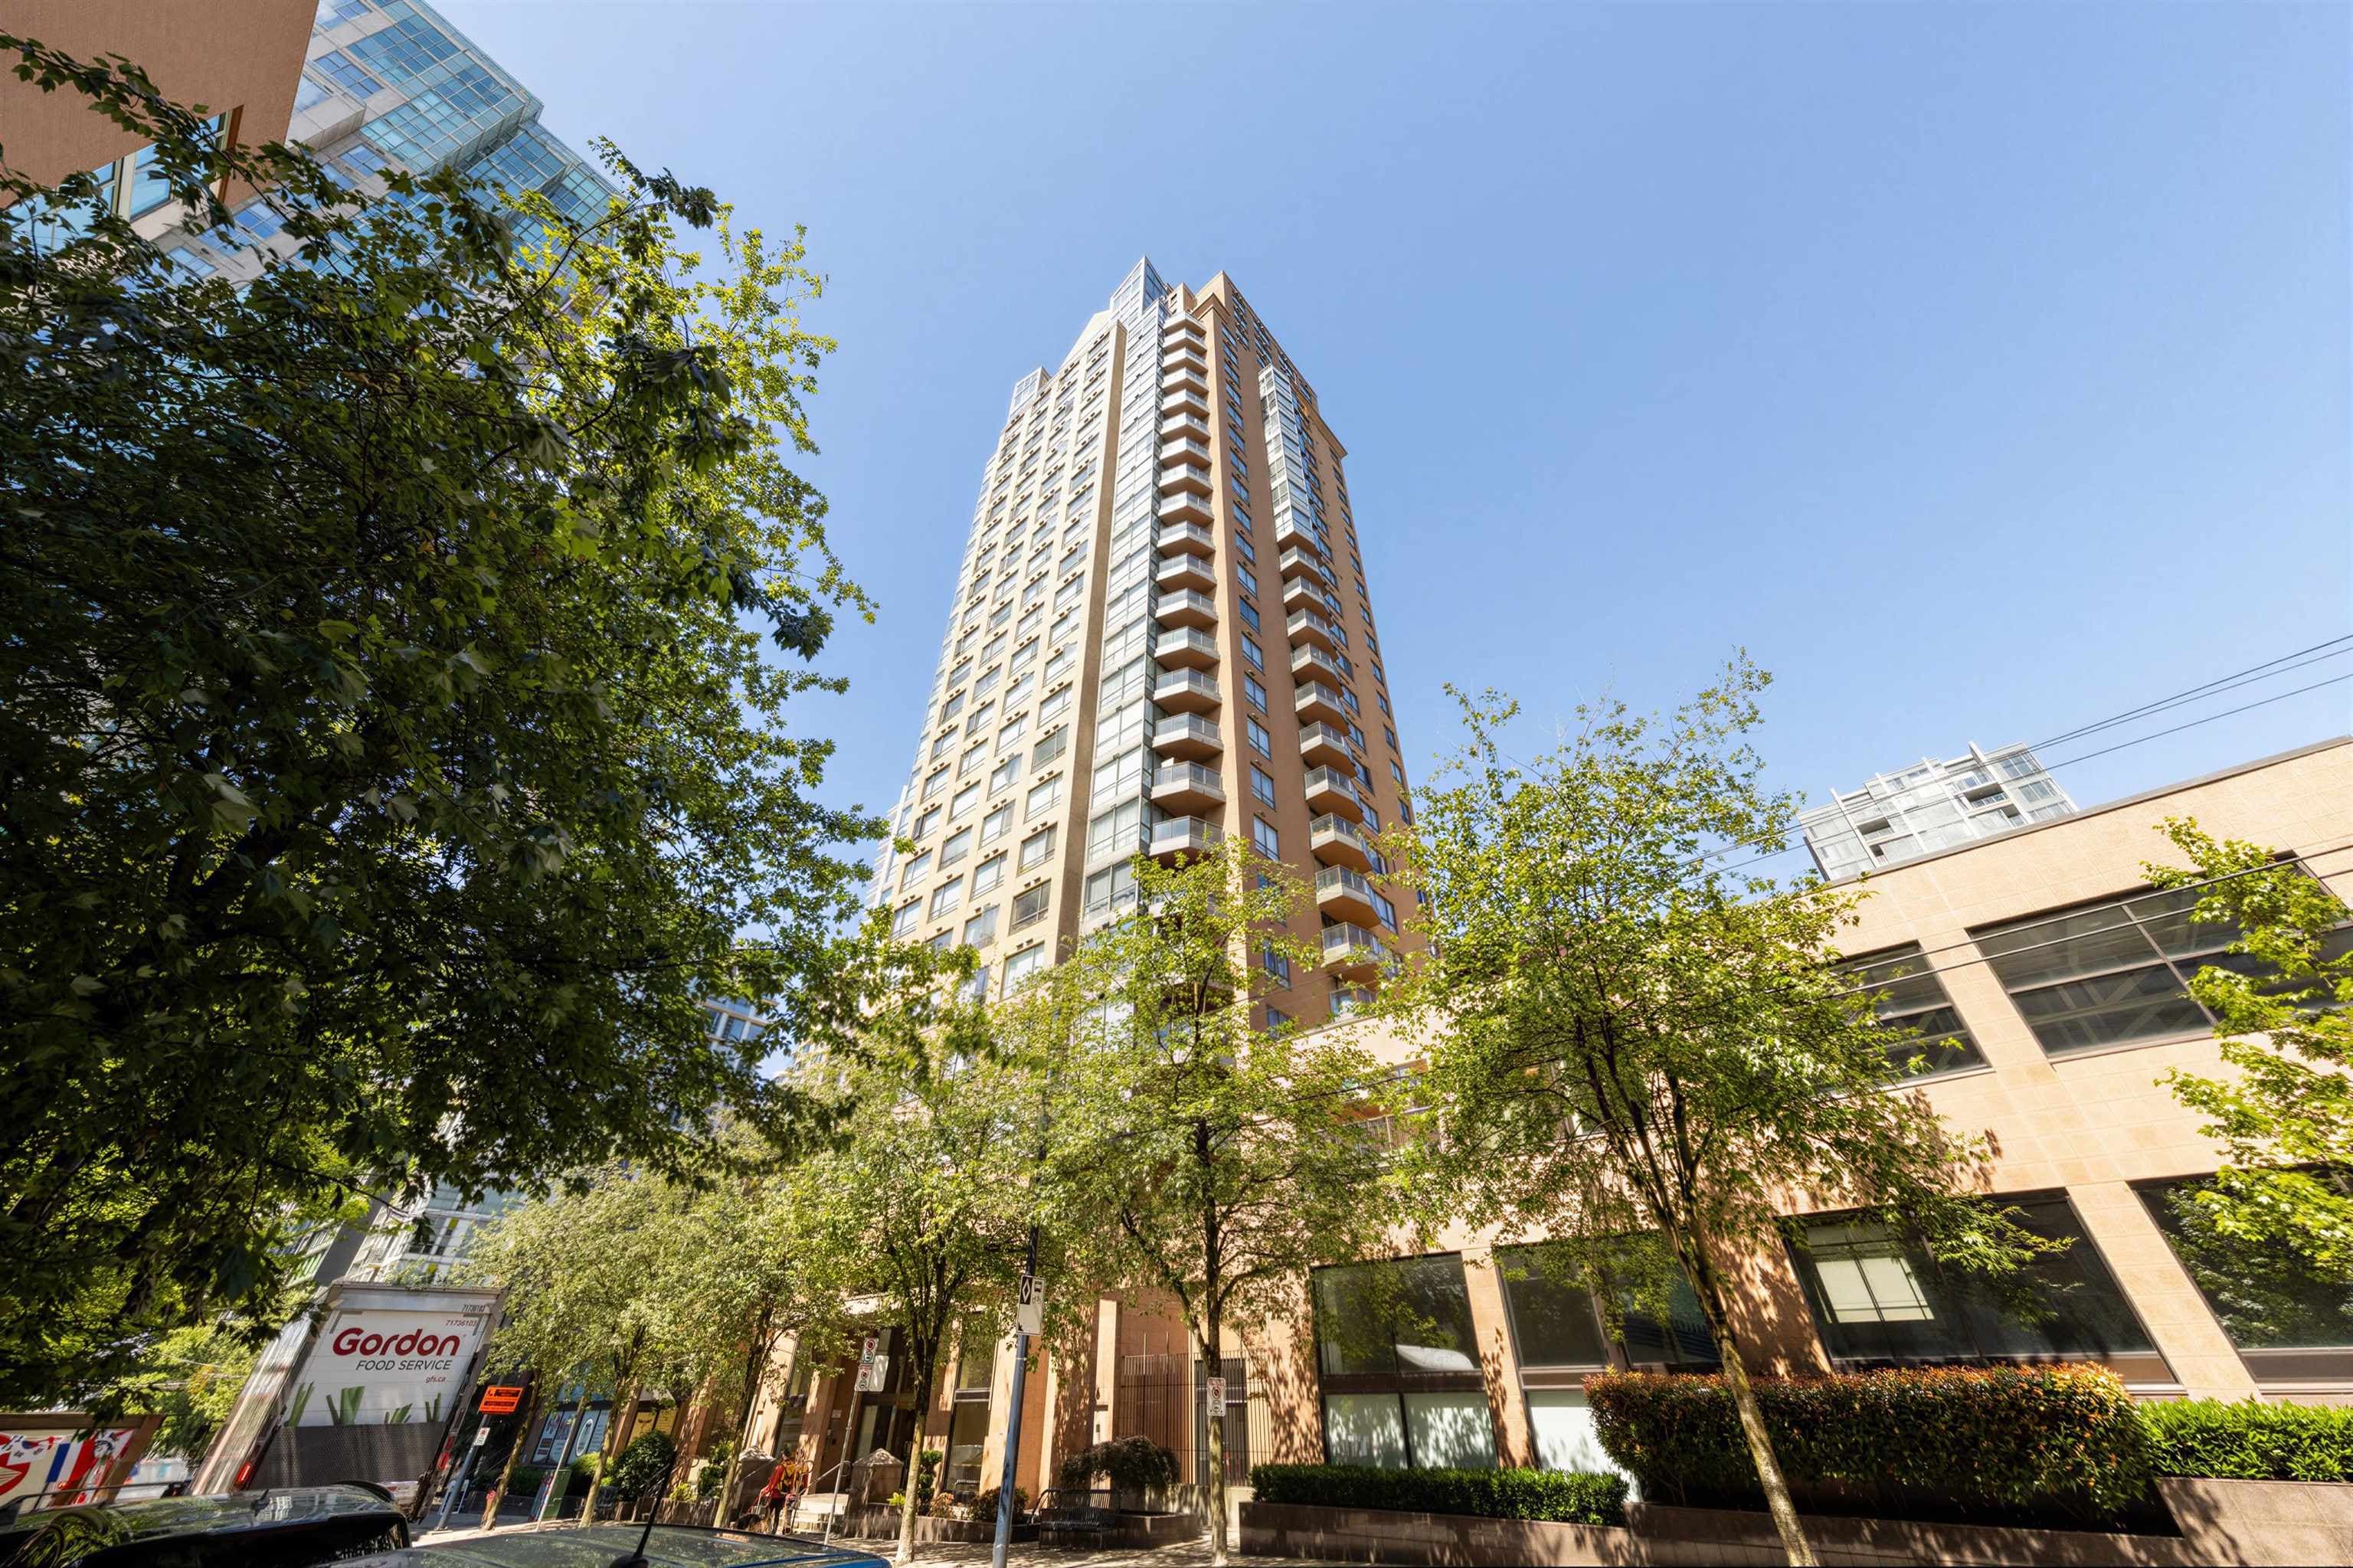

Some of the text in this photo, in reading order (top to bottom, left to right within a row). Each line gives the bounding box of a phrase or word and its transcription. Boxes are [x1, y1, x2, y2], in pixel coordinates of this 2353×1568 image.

[332, 1327, 460, 1356] Gordon
[356, 1360, 453, 1370] FOOD SERVICE
